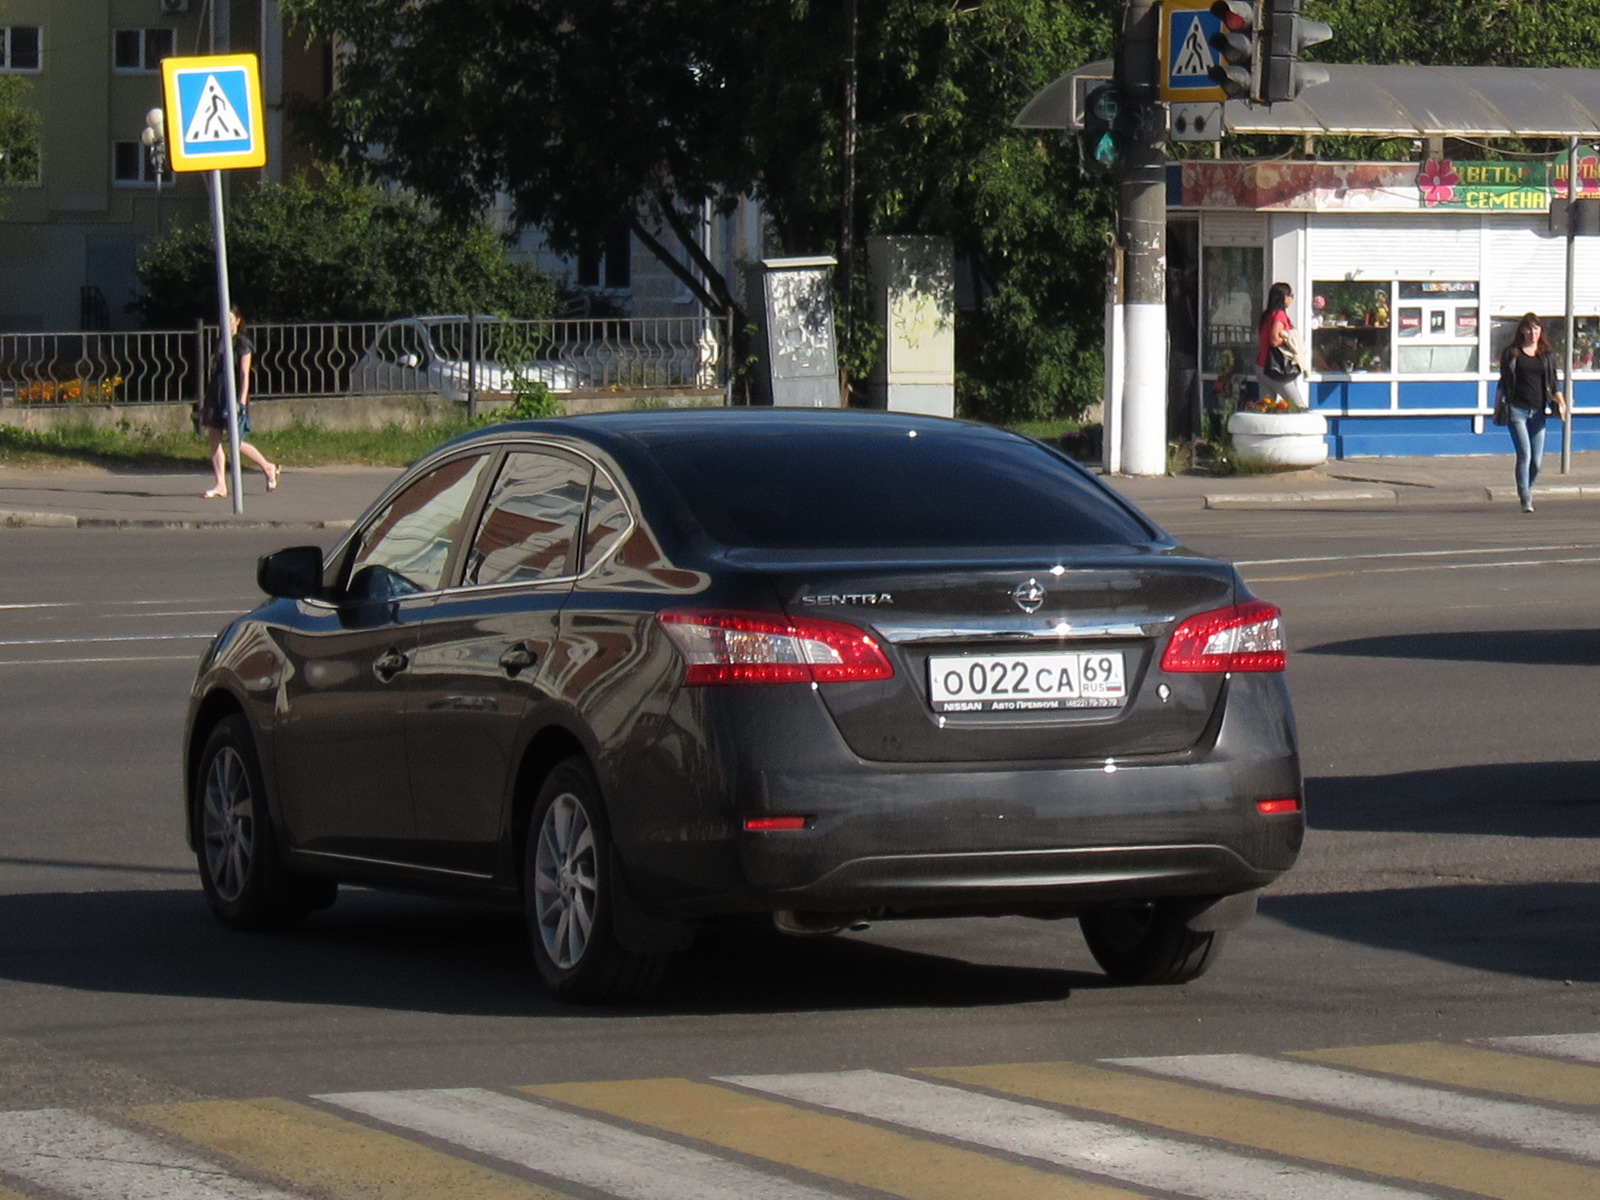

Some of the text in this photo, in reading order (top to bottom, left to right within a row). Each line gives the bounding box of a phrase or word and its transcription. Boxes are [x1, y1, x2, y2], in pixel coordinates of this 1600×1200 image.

[1466, 191, 1545, 209] СЕМЕНА
[801, 593, 895, 606] SENTRA
[1083, 657, 1113, 682] 69
[1082, 682, 1105, 693] RUS
[943, 701, 982, 712] NISSAN
